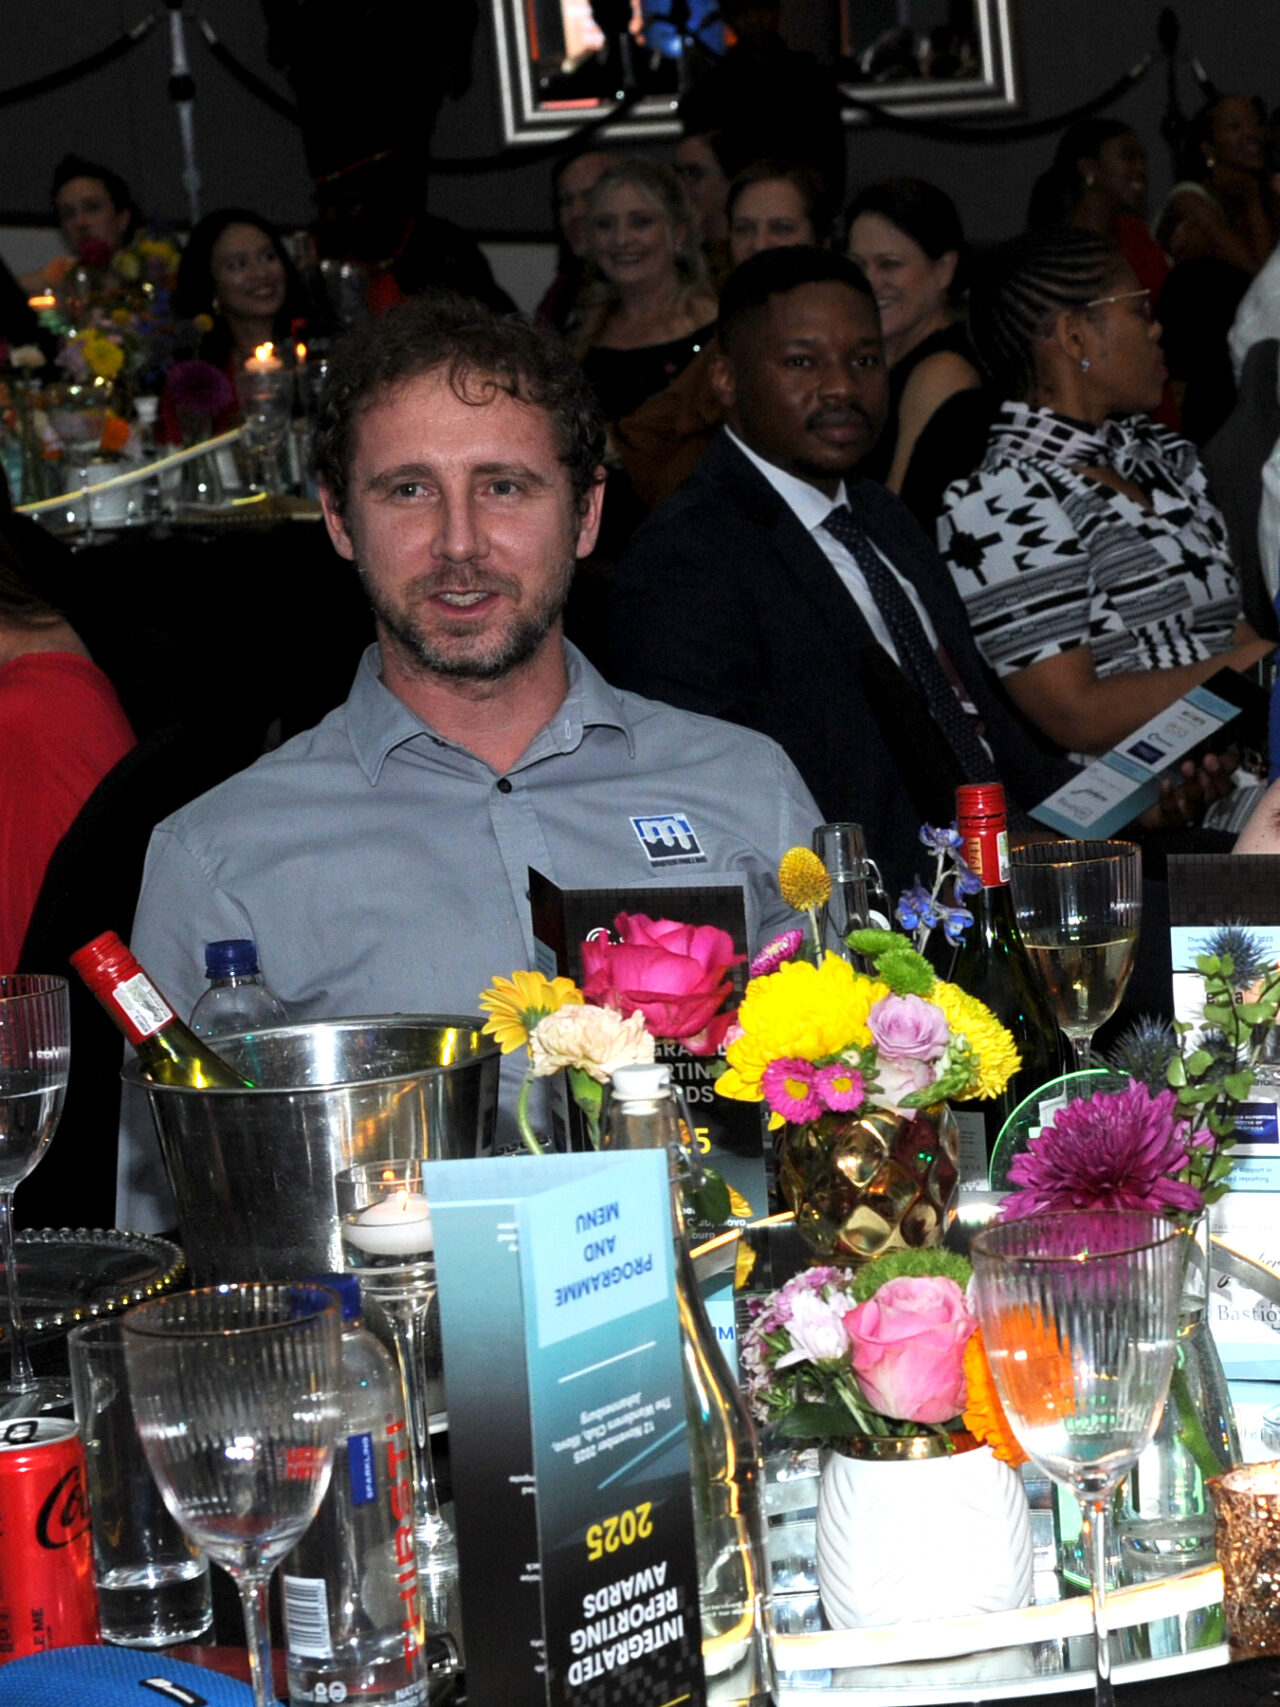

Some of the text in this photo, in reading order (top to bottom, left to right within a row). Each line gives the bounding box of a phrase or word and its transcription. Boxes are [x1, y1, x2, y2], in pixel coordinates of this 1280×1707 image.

[575, 1202, 620, 1234] MENU
[583, 1235, 617, 1262] AND
[554, 1254, 653, 1307] PROGRAMME
[363, 1436, 376, 1500] SPARKLING
[585, 1501, 653, 1561] 2025
[582, 1561, 667, 1618] AWARDS
[570, 1587, 678, 1653] REPORTING
[568, 1615, 684, 1686] INTEGRATED
